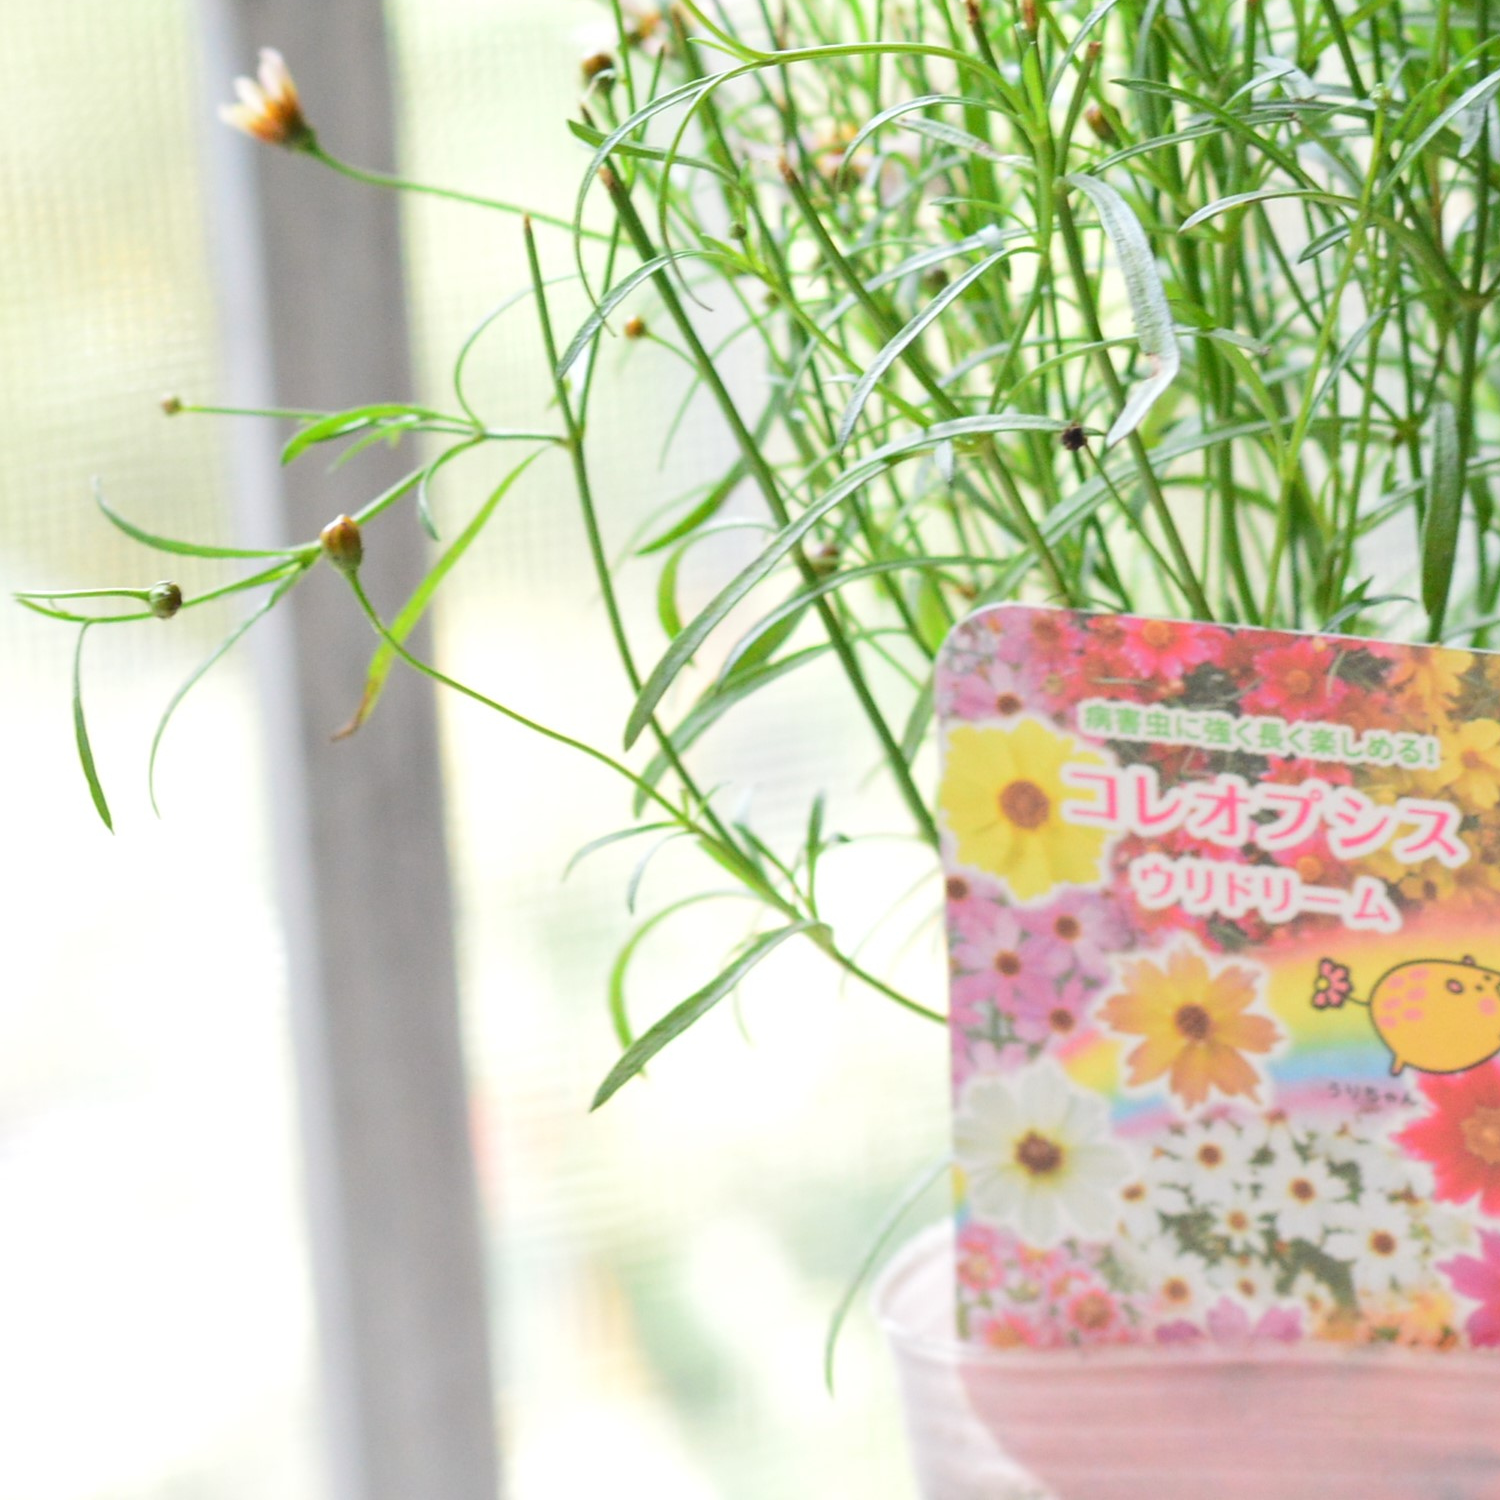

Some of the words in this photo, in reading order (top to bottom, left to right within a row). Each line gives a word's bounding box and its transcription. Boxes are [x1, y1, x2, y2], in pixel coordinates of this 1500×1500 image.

[1070, 773, 1459, 858] コレオプシス
[1140, 863, 1391, 924] ウリドリーム
